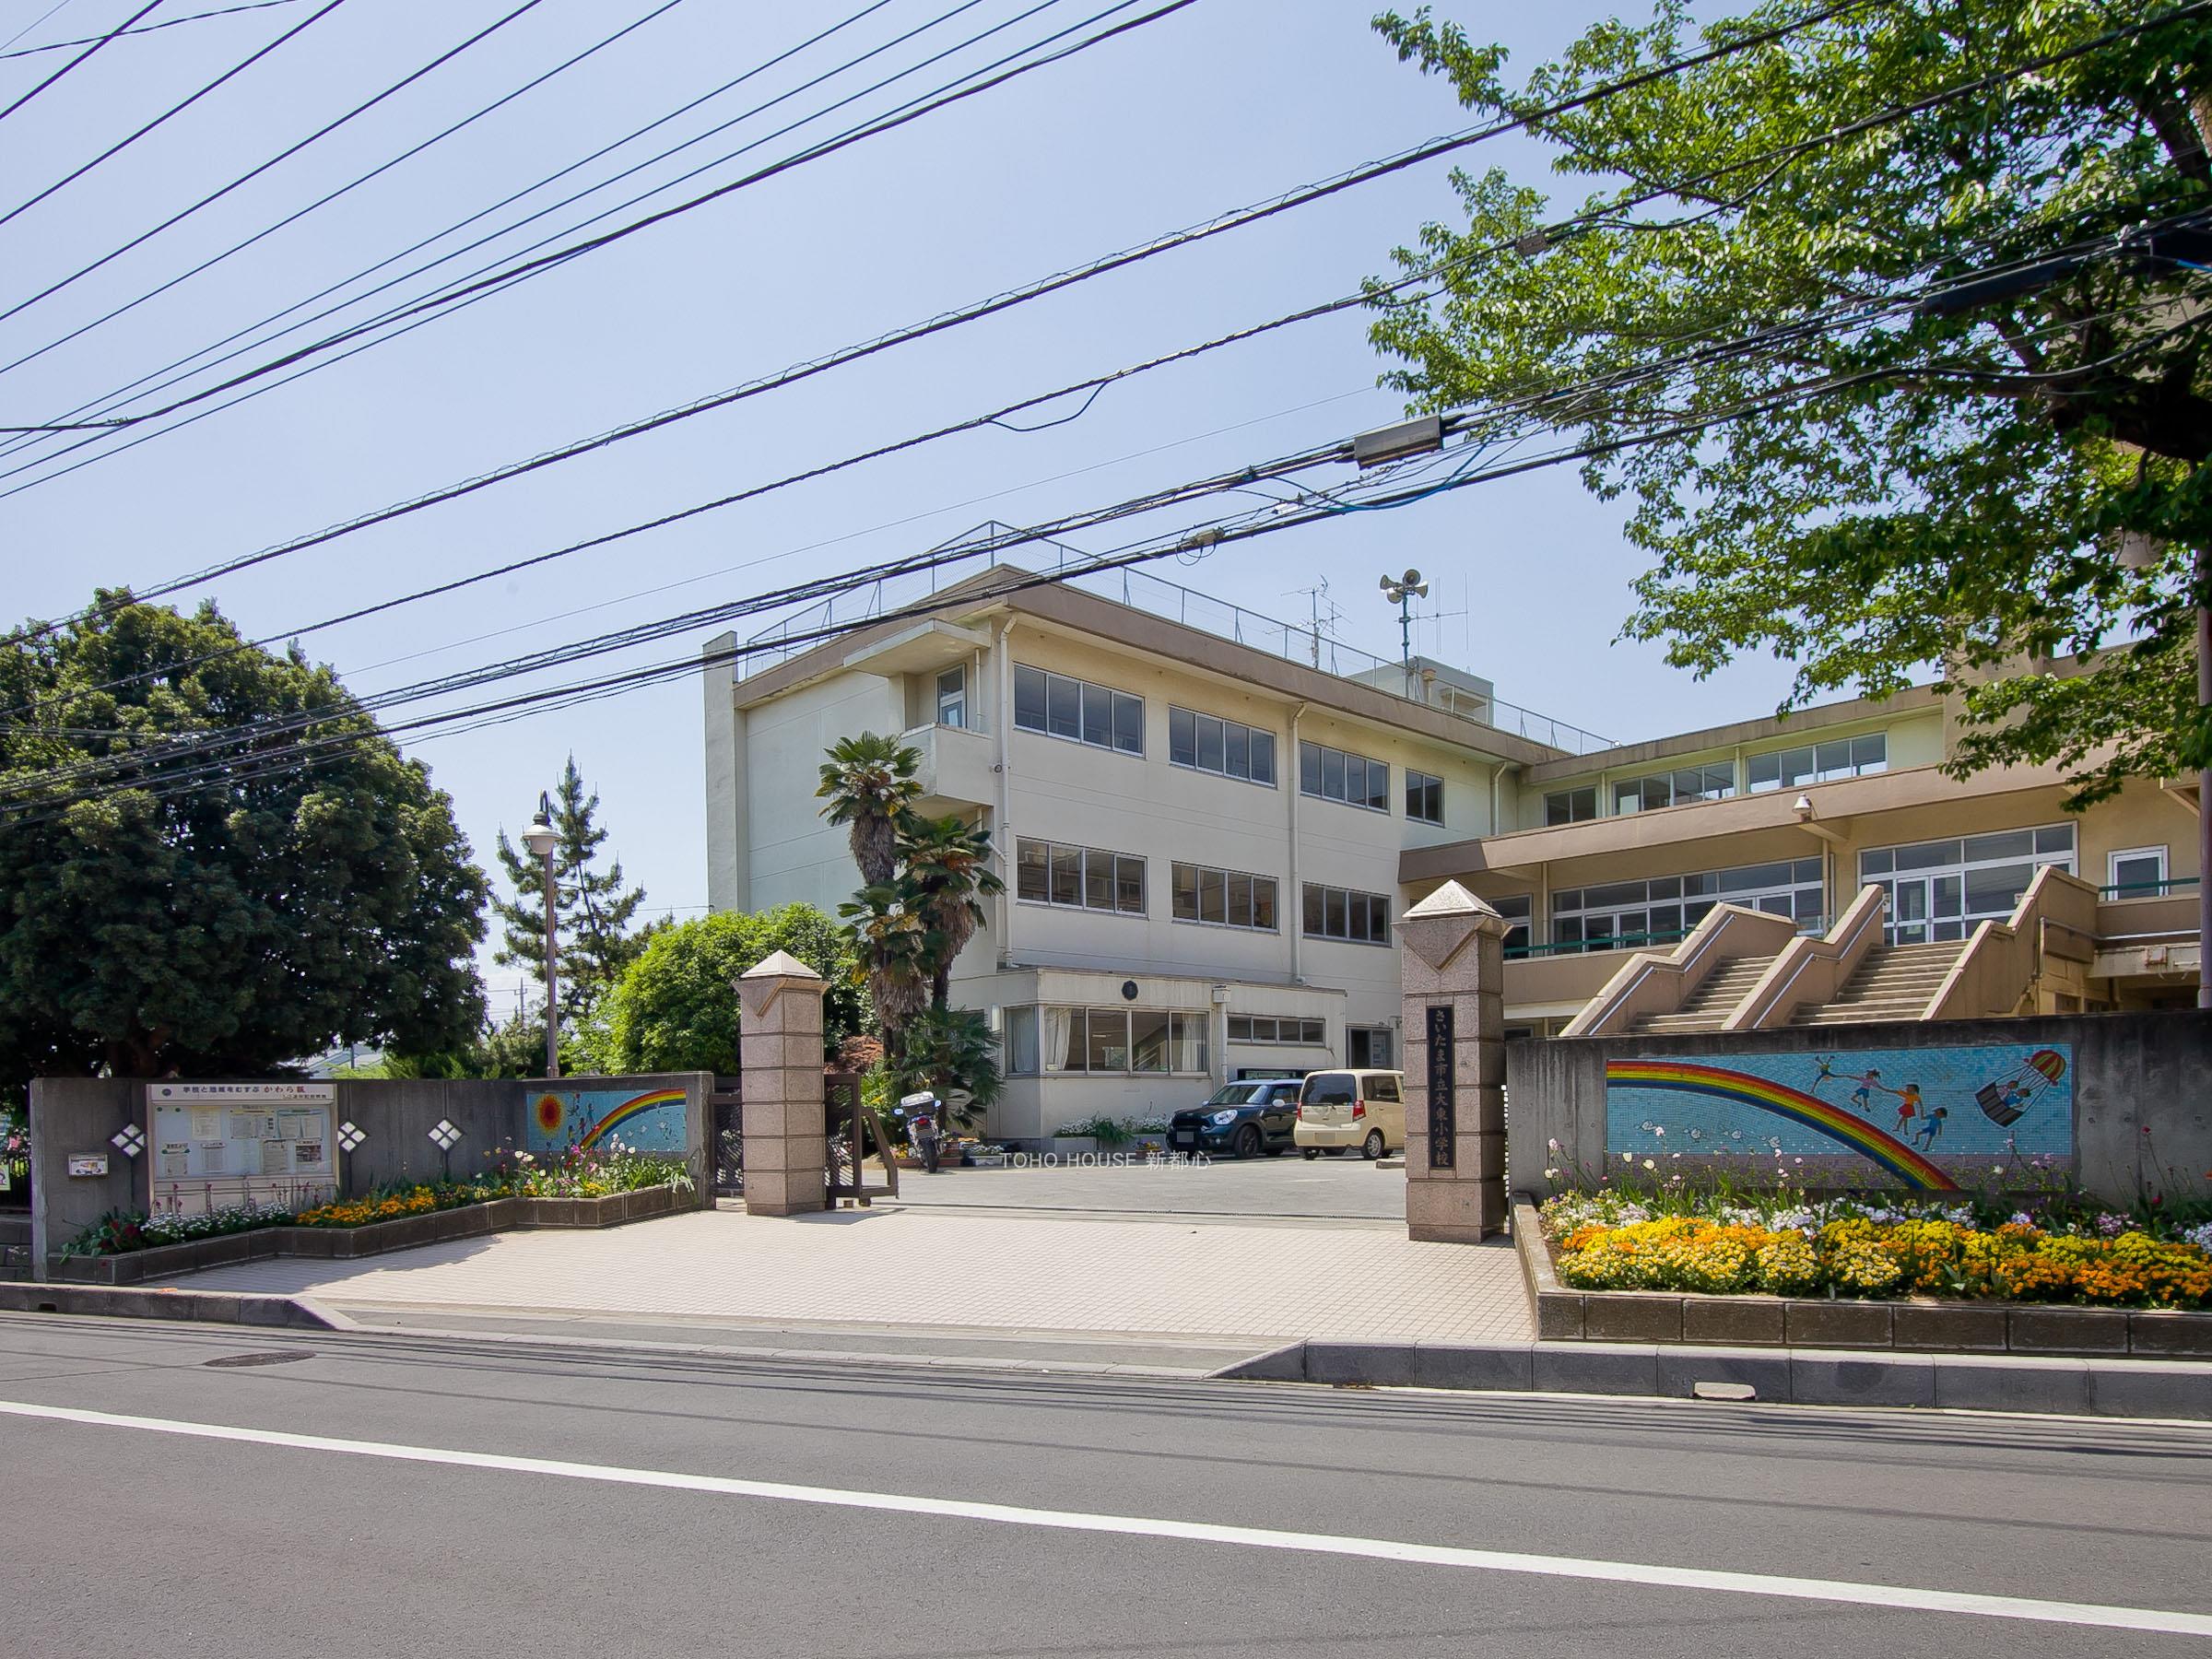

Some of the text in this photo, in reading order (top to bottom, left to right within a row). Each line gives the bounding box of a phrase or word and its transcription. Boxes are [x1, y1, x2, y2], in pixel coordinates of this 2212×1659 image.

[1434, 1010, 1449, 1166] さいたま市立大東小学校
